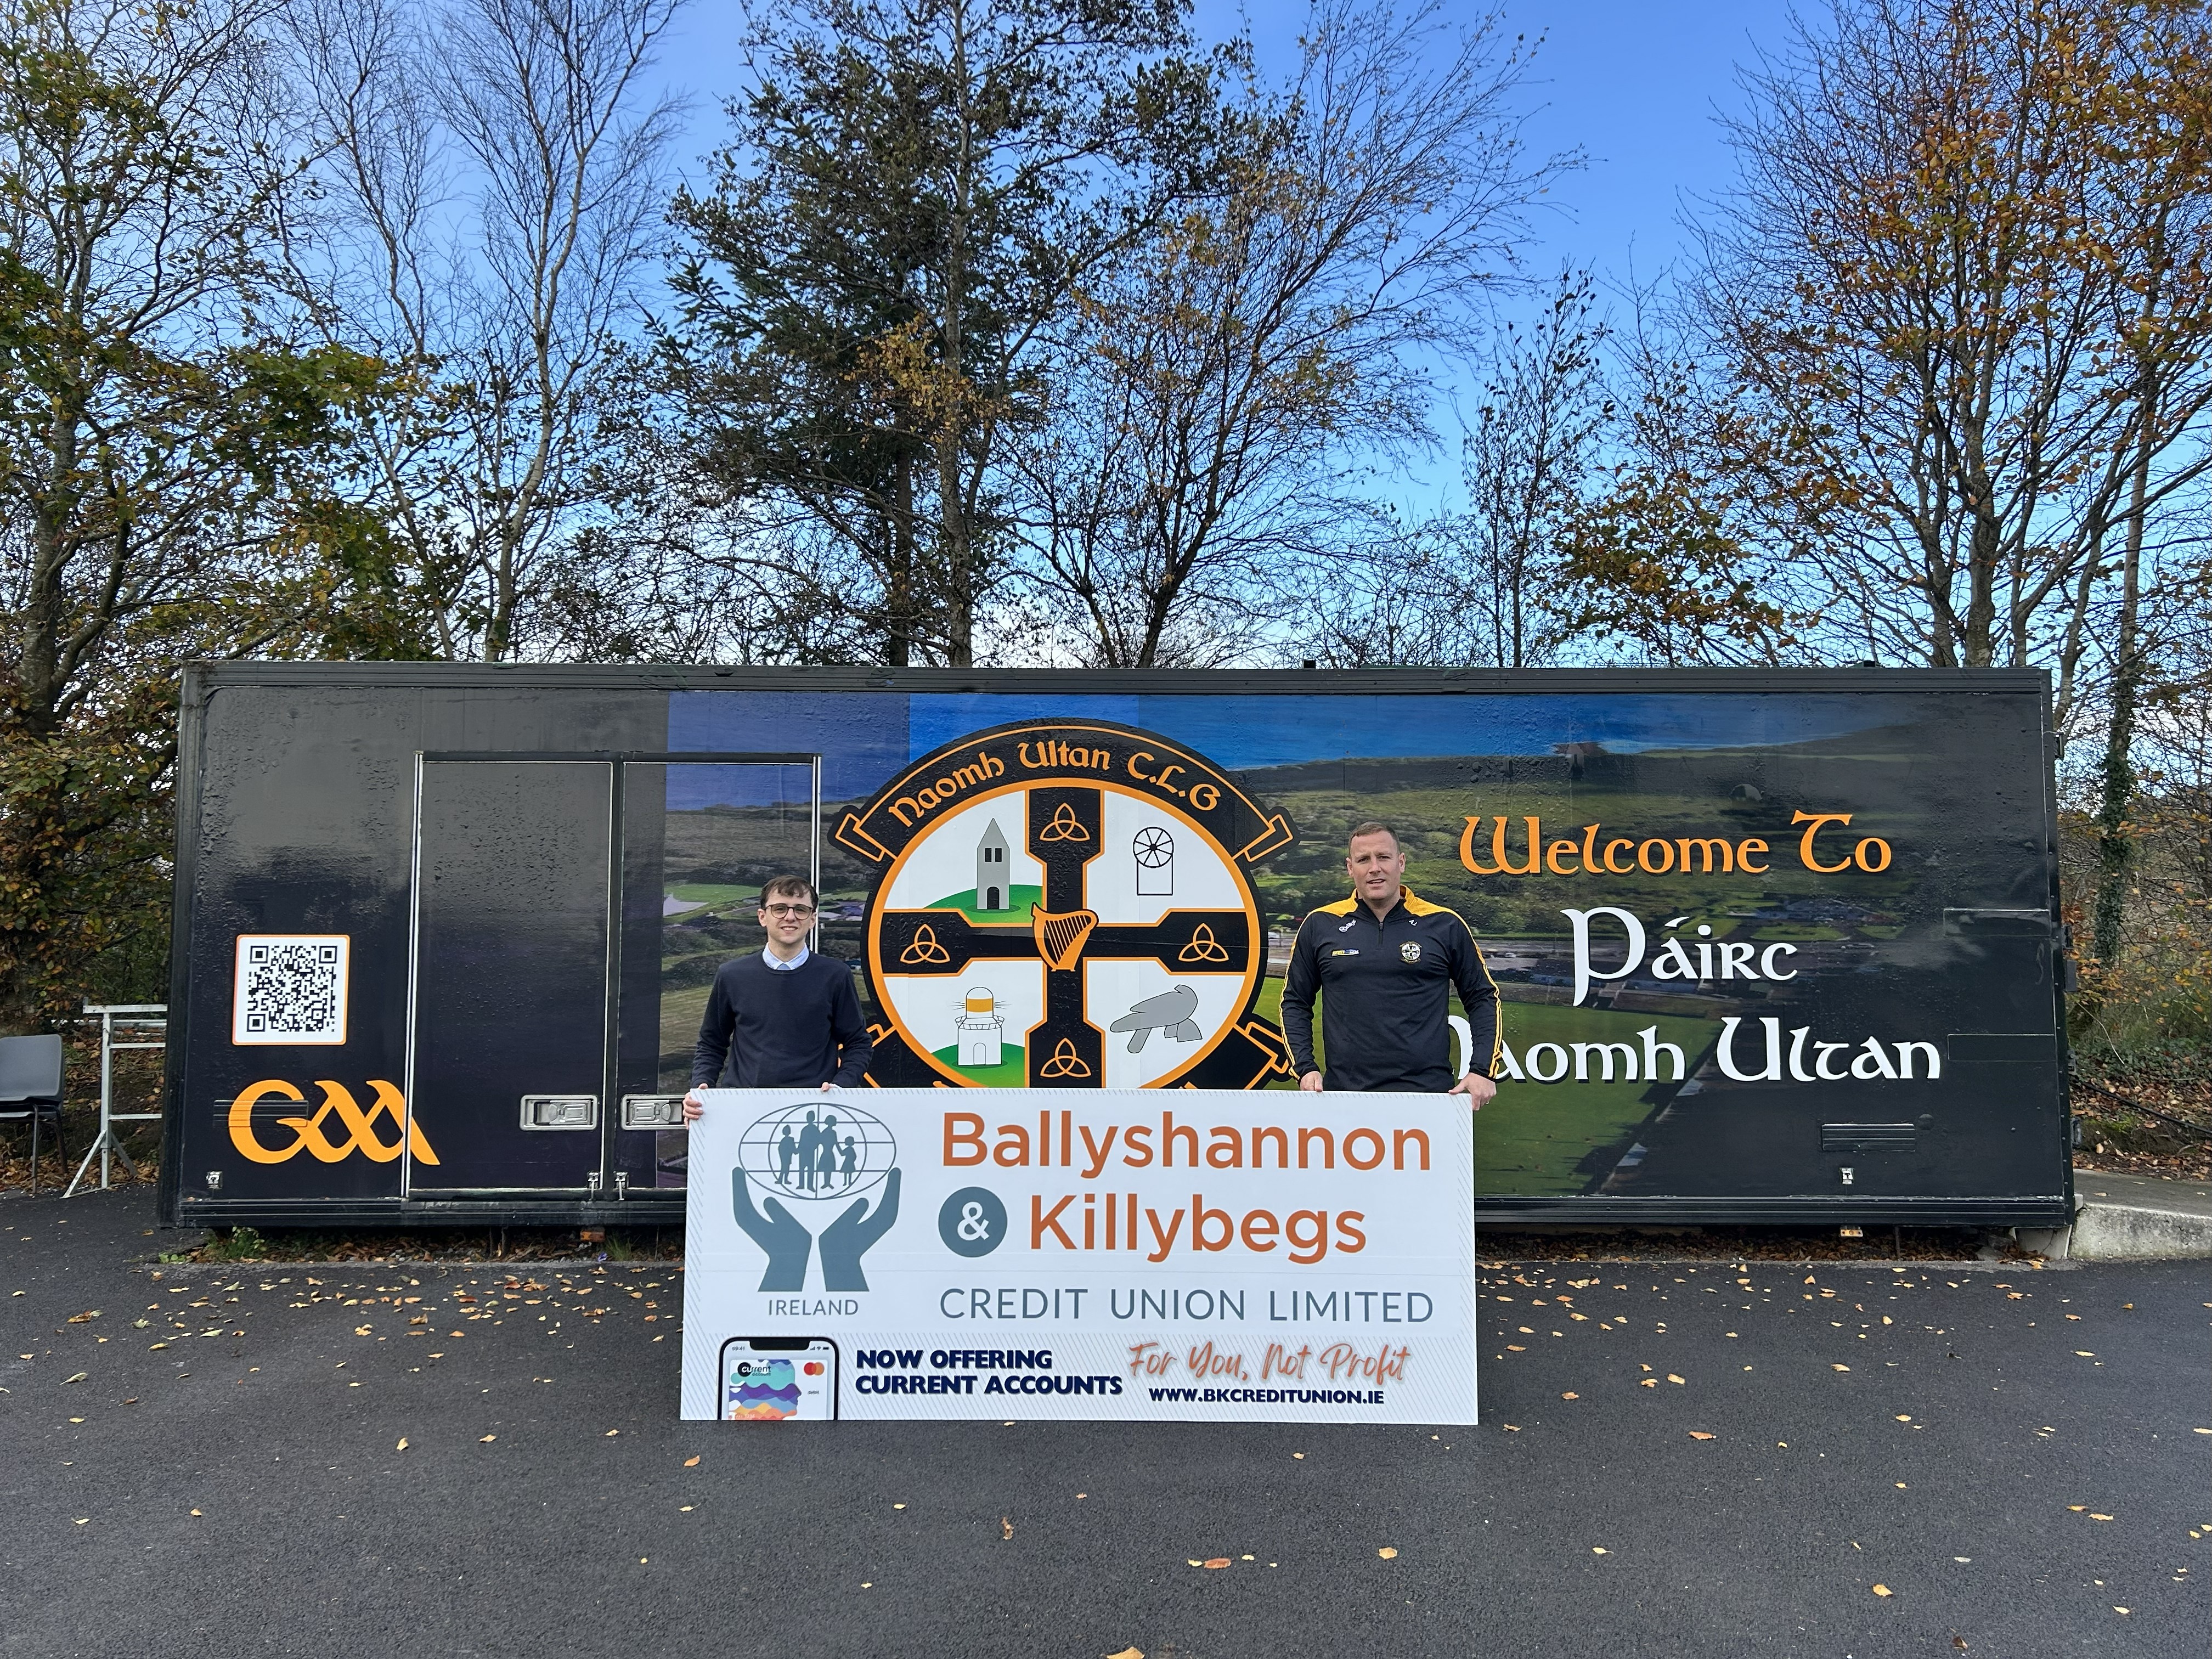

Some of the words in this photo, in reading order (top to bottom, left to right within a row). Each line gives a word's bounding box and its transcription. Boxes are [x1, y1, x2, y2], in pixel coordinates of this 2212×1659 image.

[888, 751, 1005, 827] Naomh
[1018, 740, 1110, 771] Ultan
[1459, 816, 1769, 875] Welcome
[1791, 810, 1892, 872] To
[1717, 1017, 1940, 1082] Ultan
[228, 1079, 441, 1165] GAA
[943, 1110, 1430, 1179] Ballyshannon
[957, 1201, 990, 1242] &
[1031, 1193, 1366, 1265] Killybegs
[768, 1299, 859, 1316] IRELAND
[940, 1288, 1088, 1319] CREDIT
[1110, 1288, 1245, 1321] UNION
[1270, 1290, 1434, 1323] LIMITED
[855, 1375, 978, 1395] CURRENT
[984, 1375, 1123, 1396] ACCOUNTS
[856, 1350, 924, 1369] NOW
[930, 1349, 1052, 1369] OFFERING
[1129, 1341, 1177, 1377] For
[1187, 1340, 1249, 1381] You,
[1261, 1343, 1311, 1380] Not
[1319, 1342, 1412, 1386] Profit
[1148, 1387, 1385, 1404] WWW.BKCREDITUNION.IE
